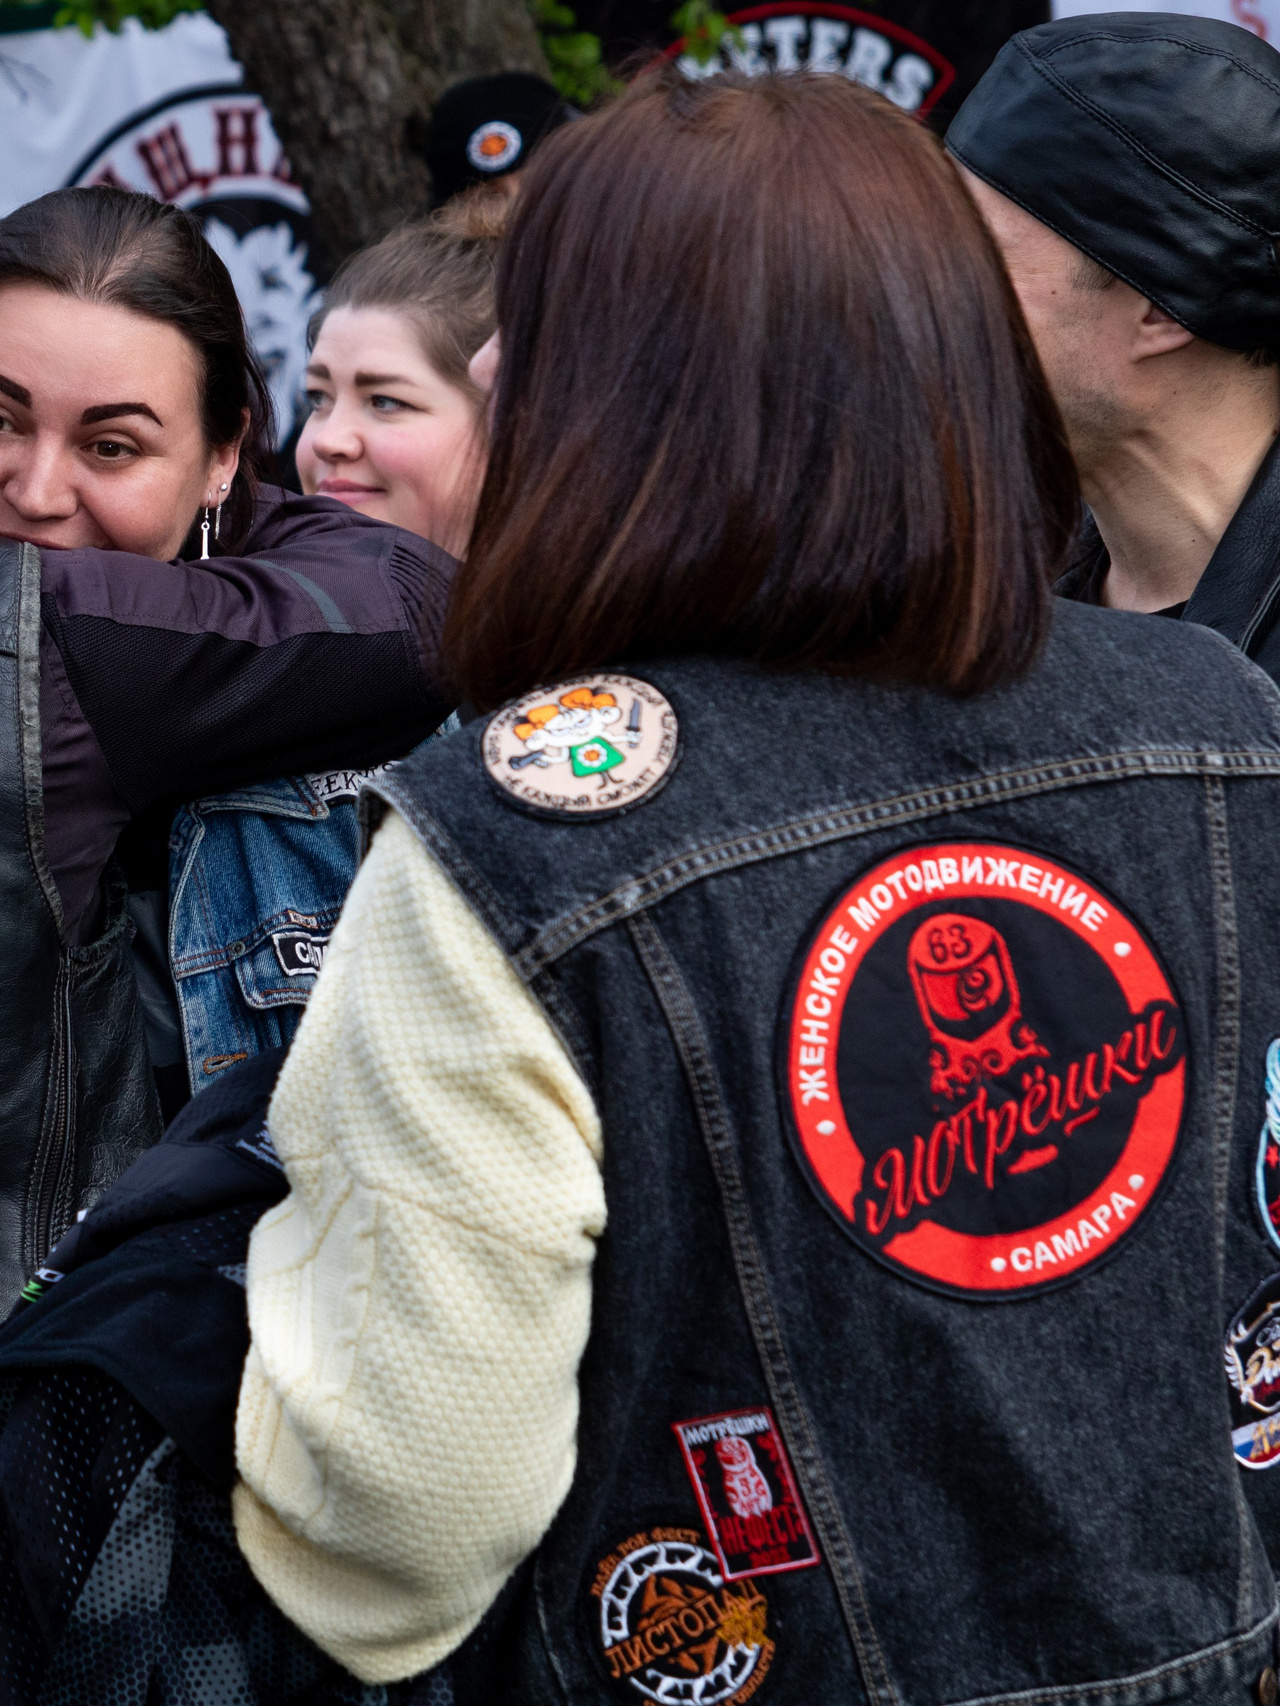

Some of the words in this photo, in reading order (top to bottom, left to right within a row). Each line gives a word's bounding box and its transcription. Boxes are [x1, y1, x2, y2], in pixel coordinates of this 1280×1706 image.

[800, 925, 858, 1106] ЖЕНСКОЕ
[847, 856, 1109, 932] МОТОДВИЖЕНИЕ
[927, 923, 972, 964] 63
[1010, 1191, 1137, 1273] САМАРА
[604, 1578, 767, 1679] ЛИСТОПАД
